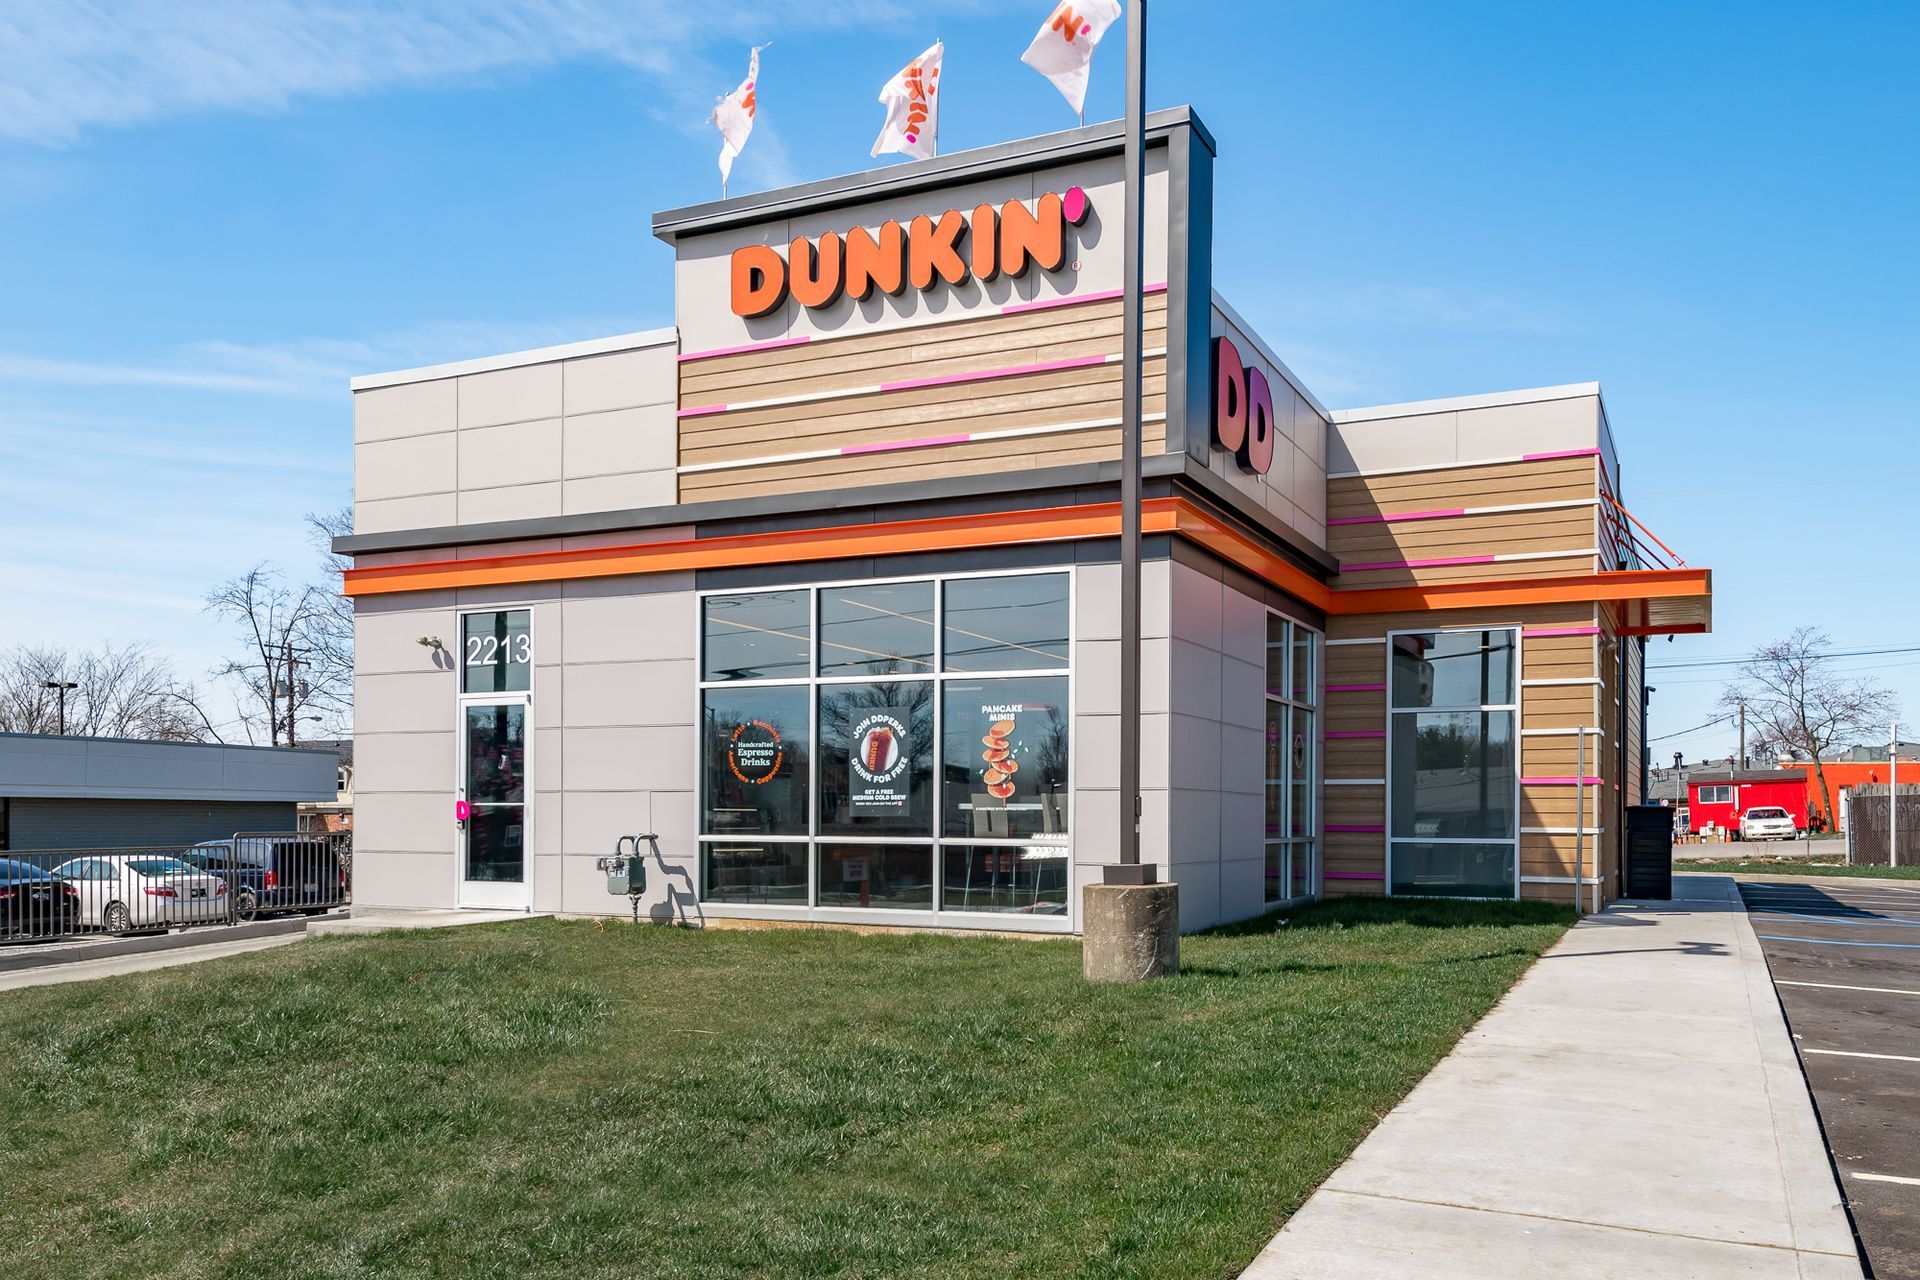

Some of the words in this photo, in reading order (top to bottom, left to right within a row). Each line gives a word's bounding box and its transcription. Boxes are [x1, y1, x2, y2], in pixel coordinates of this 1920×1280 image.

[731, 186, 1088, 317] DUNKIN'
[1212, 336, 1275, 475] DD
[466, 633, 531, 666] 2213
[981, 704, 1024, 714] PANCAKE
[989, 713, 1016, 722] MINIS
[853, 718, 870, 739] JOIN
[737, 748, 775, 758] Espresso
[740, 757, 771, 766] Drinks
[851, 758, 872, 782] DRINK
[874, 774, 891, 783] FOR
[890, 756, 908, 778] FREE
